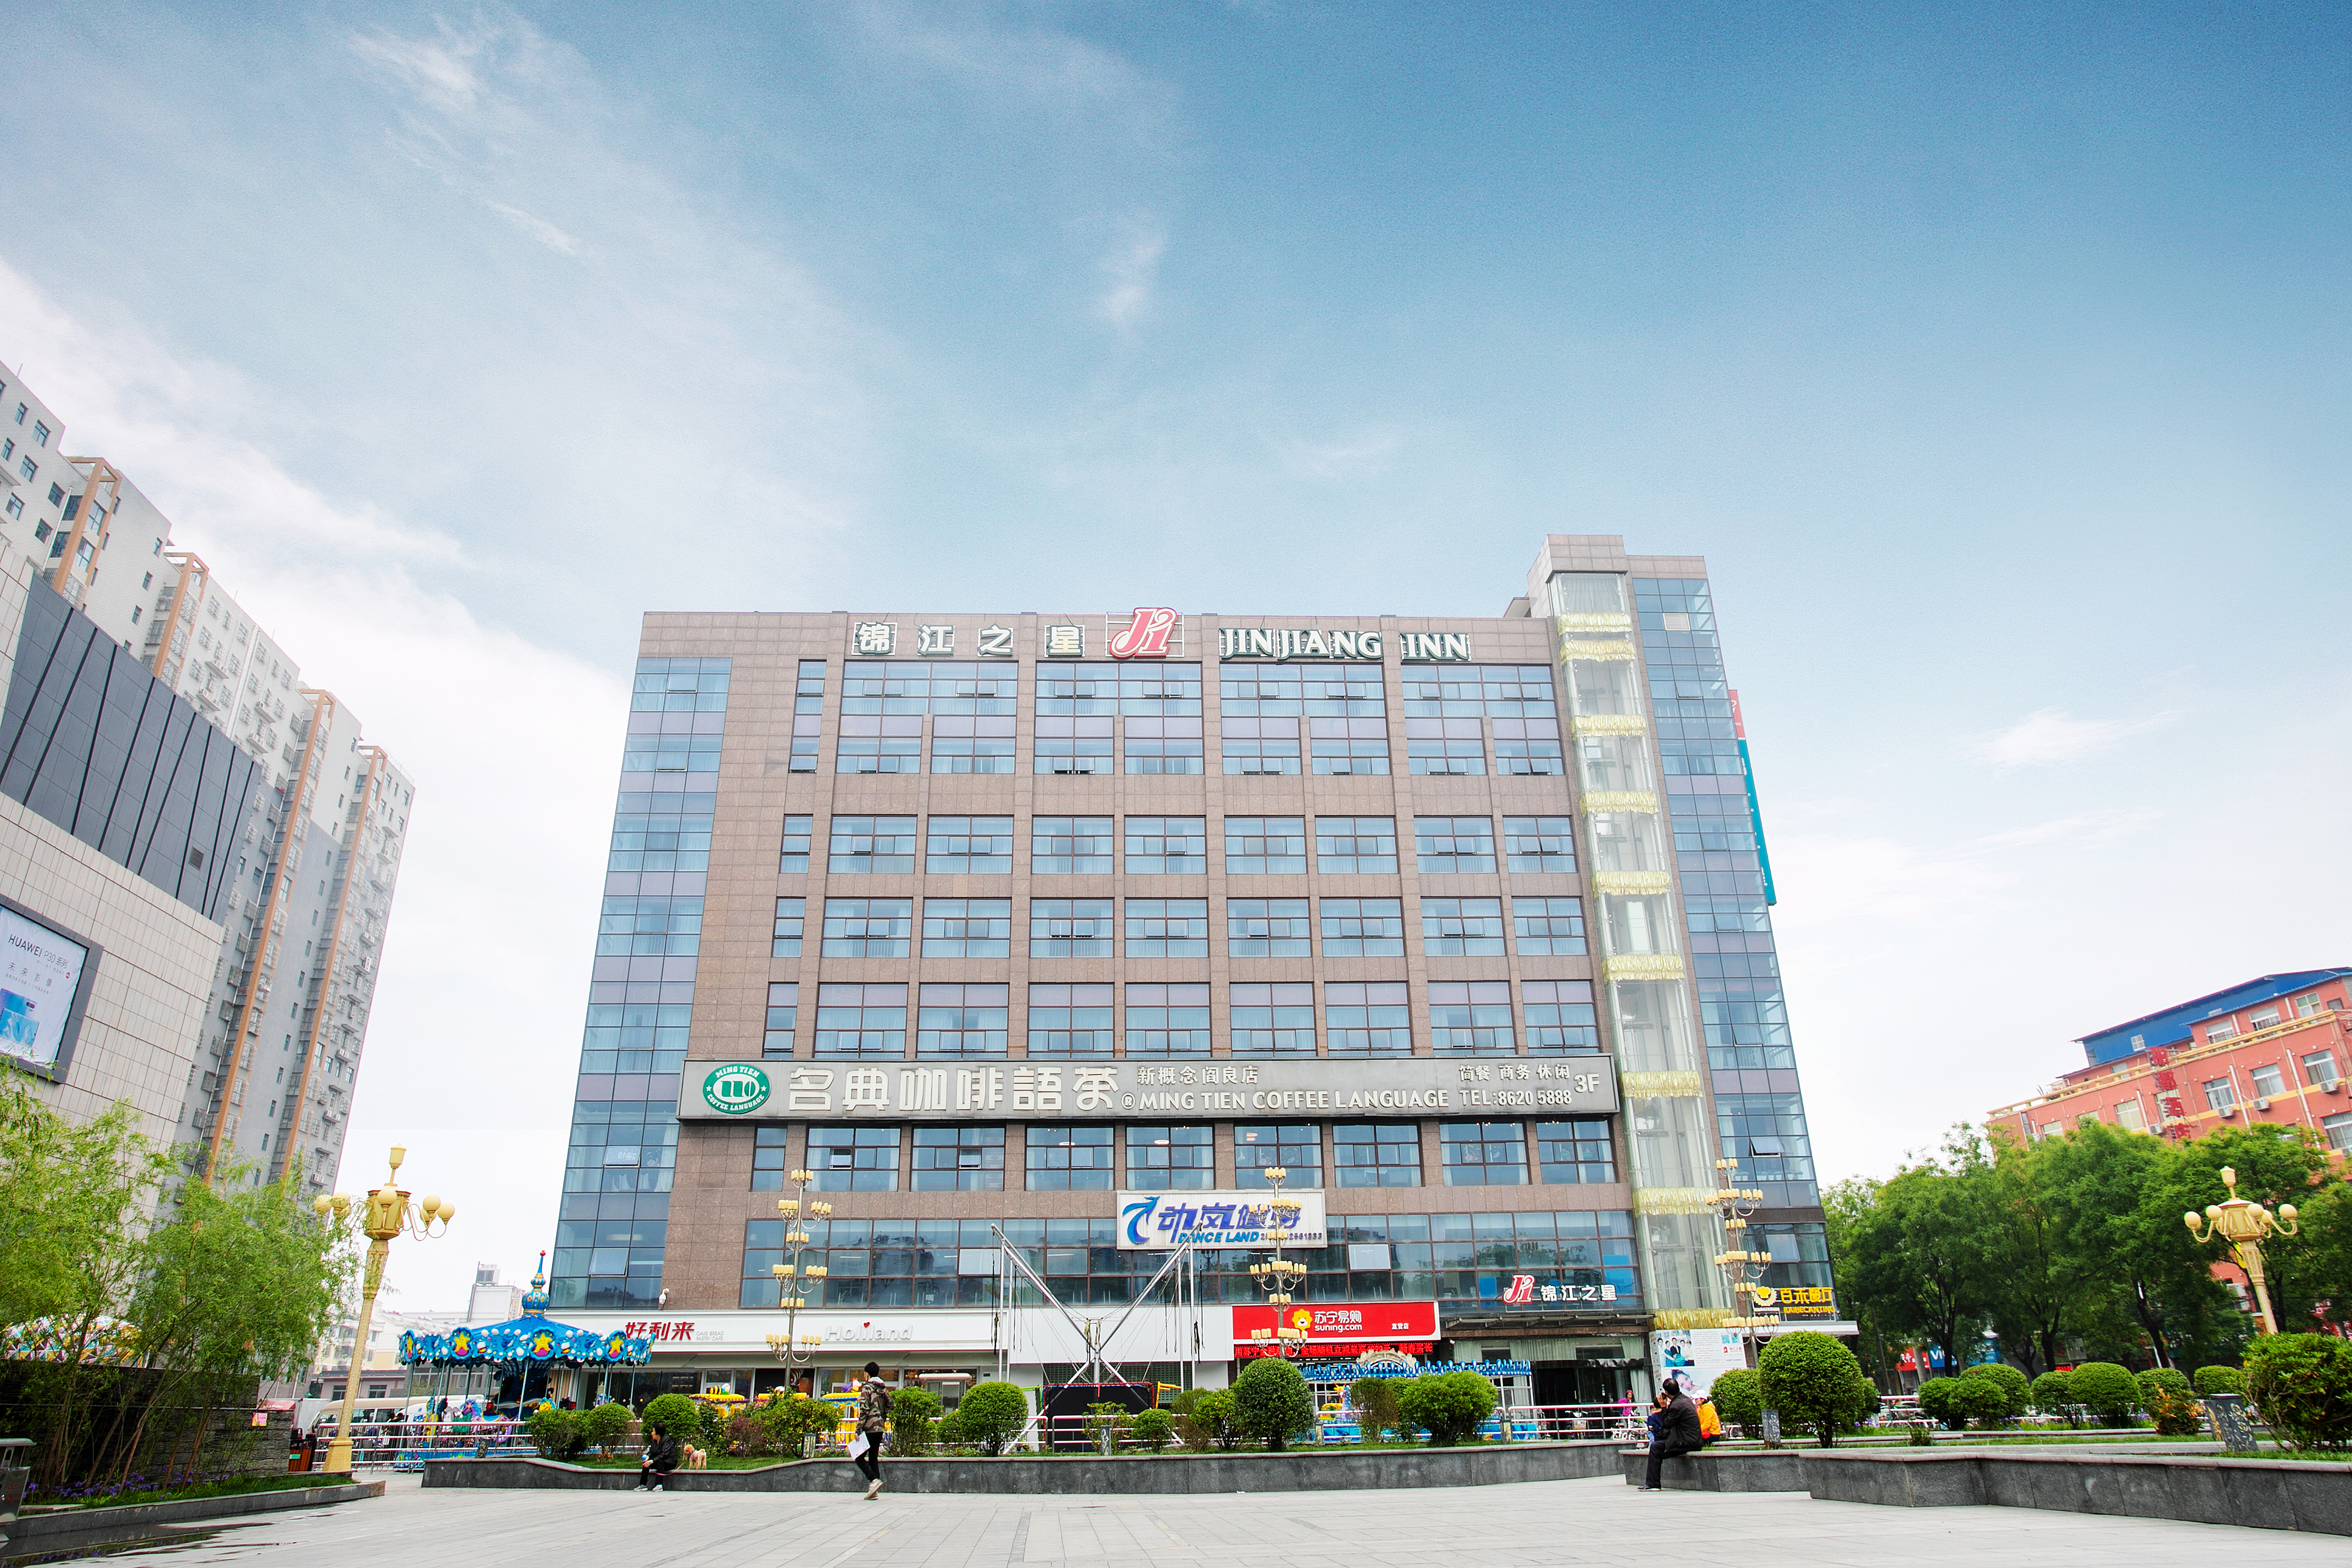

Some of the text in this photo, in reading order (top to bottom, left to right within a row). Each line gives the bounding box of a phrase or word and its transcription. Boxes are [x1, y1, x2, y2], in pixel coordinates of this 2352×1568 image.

[856, 621, 1083, 656] 锦江之星
[1220, 628, 1469, 661] JINJIANG INN
[8, 934, 43, 957] HUAWEI
[44, 951, 56, 963] P30
[56, 957, 69, 969] 系列
[8, 962, 53, 987] 未来影像
[715, 1066, 760, 1078] MING TIEN
[1137, 1065, 1259, 1085] 新概念阎良店
[1459, 1063, 1570, 1081] 简餐 商务 休闲
[1574, 1073, 1600, 1093] 3F
[707, 1093, 764, 1111] COFFEE LANGUAGE
[1138, 1093, 1195, 1110] MING
[1202, 1092, 1246, 1110] TIEN
[1252, 1090, 1329, 1109] COFFEE
[1334, 1089, 1449, 1108] LANGUAGE
[1459, 1089, 1573, 1106] TEL:8620 5888
[1225, 1231, 1259, 1242] LAND
[1540, 1284, 1618, 1302] 锦江之星
[1779, 1287, 1833, 1305] 百禾餐厅
[1314, 1310, 1362, 1324] 苏宁易购
[1783, 1306, 1835, 1314] BAIHECANTING
[625, 1322, 695, 1341] 好利来
[825, 1322, 913, 1340] Holiland
[1314, 1324, 1362, 1333] suning.com
